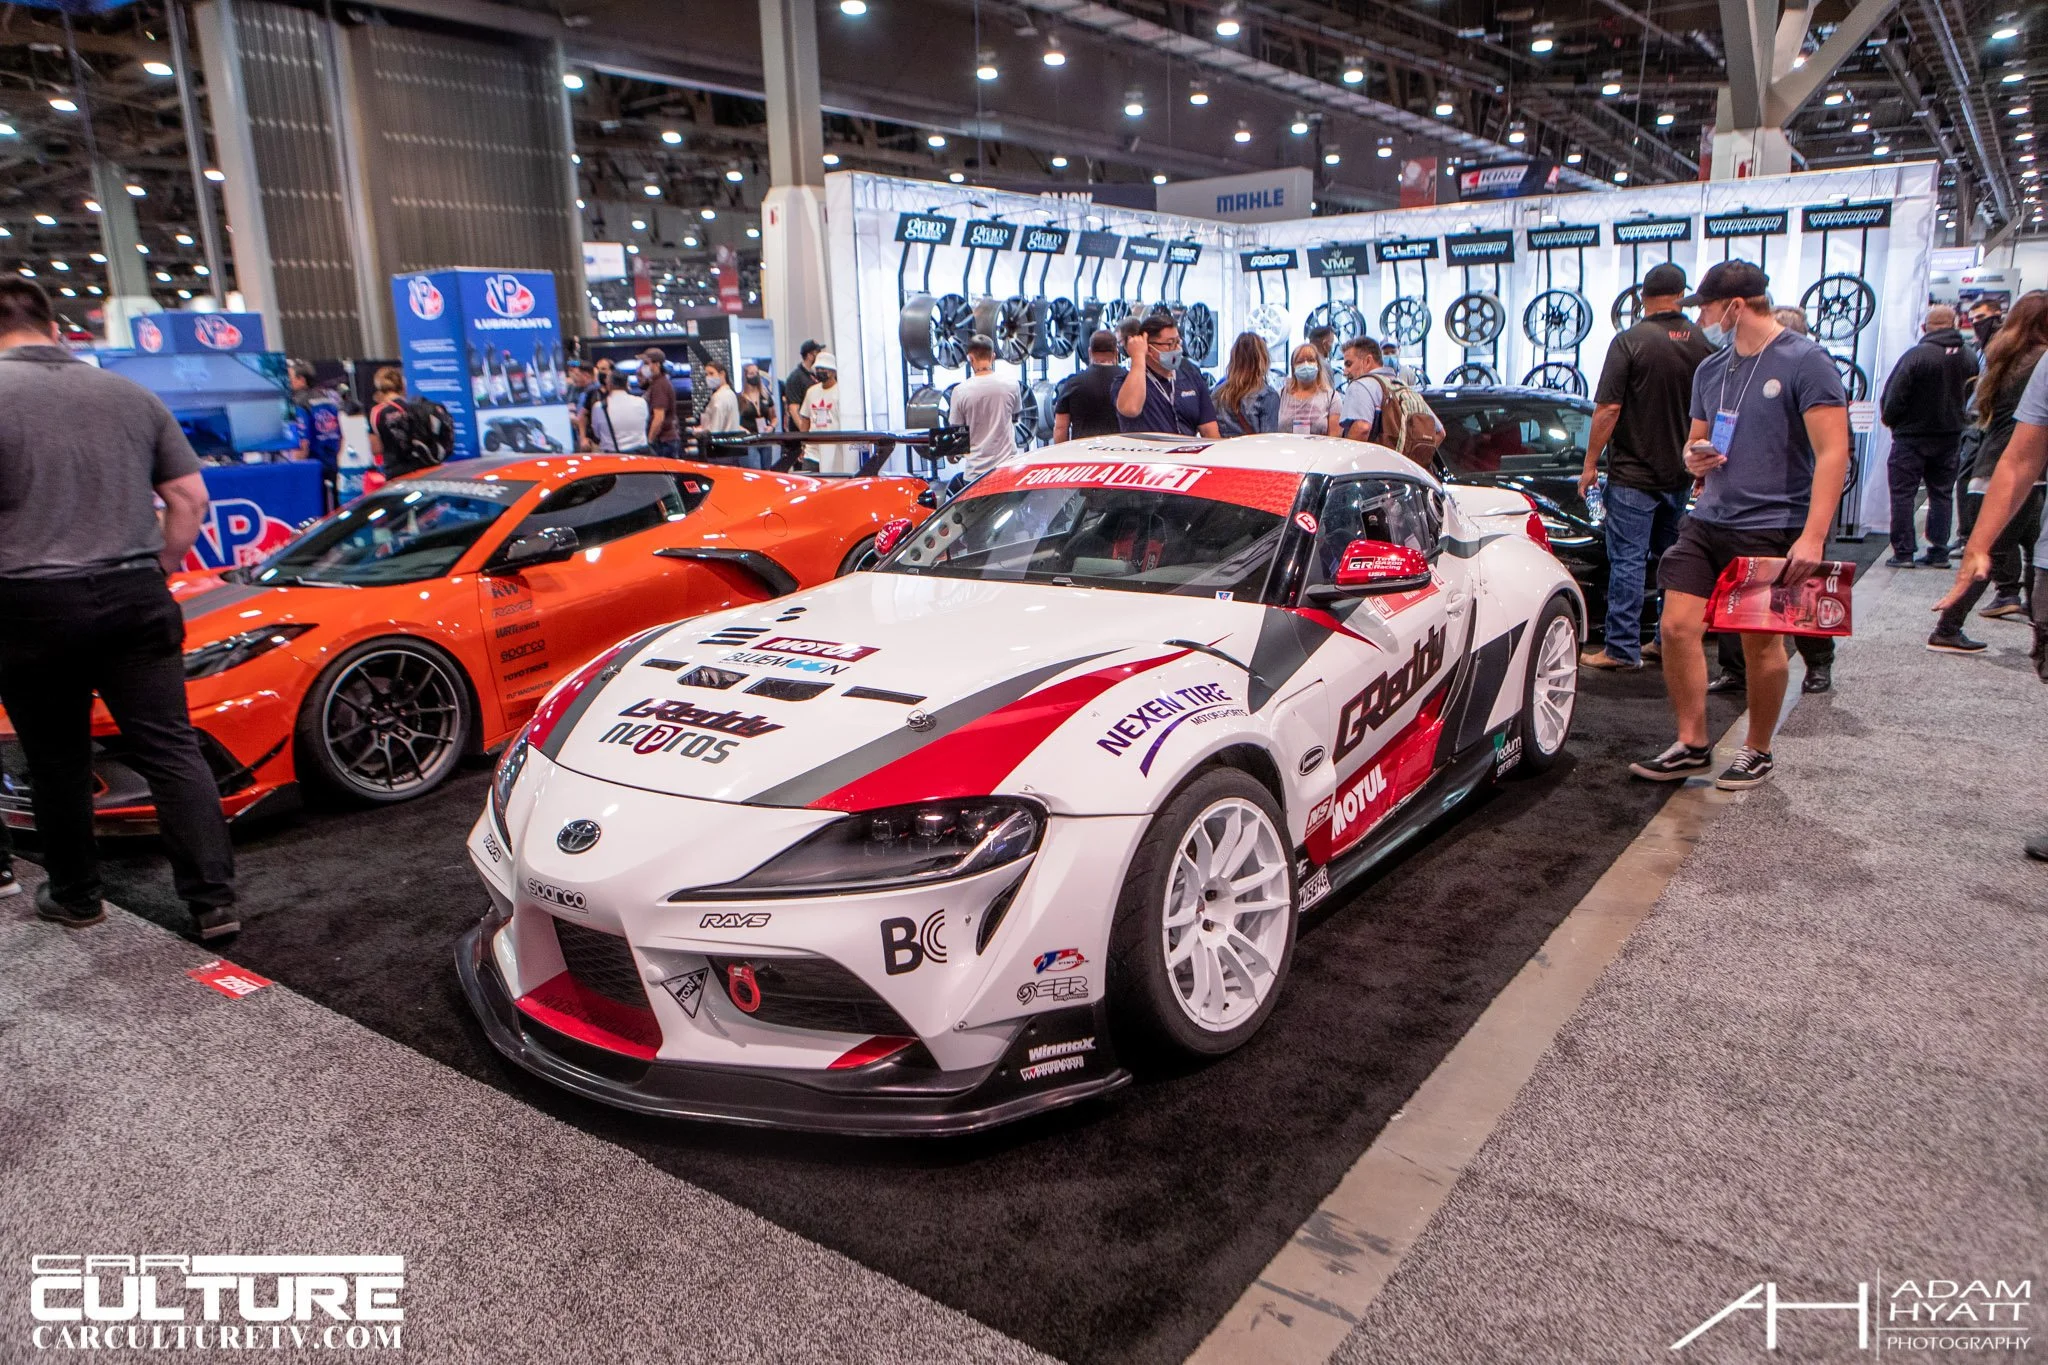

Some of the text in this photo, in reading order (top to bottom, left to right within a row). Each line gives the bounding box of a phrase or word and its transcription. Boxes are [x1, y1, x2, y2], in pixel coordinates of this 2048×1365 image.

[1216, 188, 1285, 213] MAHLE
[1250, 253, 1290, 268] RAYS
[474, 317, 553, 330] LUBRICANTS
[1016, 464, 1203, 489] FORMULA DRIFT
[1349, 561, 1373, 570] GR
[491, 583, 519, 599] KW
[501, 640, 546, 662] sparco
[762, 639, 864, 658] MOTUL
[1333, 622, 1448, 765] GReddy
[1097, 683, 1233, 757] NEXEN TIRE
[1190, 709, 1248, 726] MOTORSPORTS
[598, 721, 740, 764] nepros
[1331, 763, 1388, 841] MOTUL
[483, 833, 502, 863] RAYS
[528, 878, 588, 910] sparco
[700, 913, 772, 929] RAYS
[680, 979, 696, 1002] TOW
[1036, 975, 1089, 998] EFR
